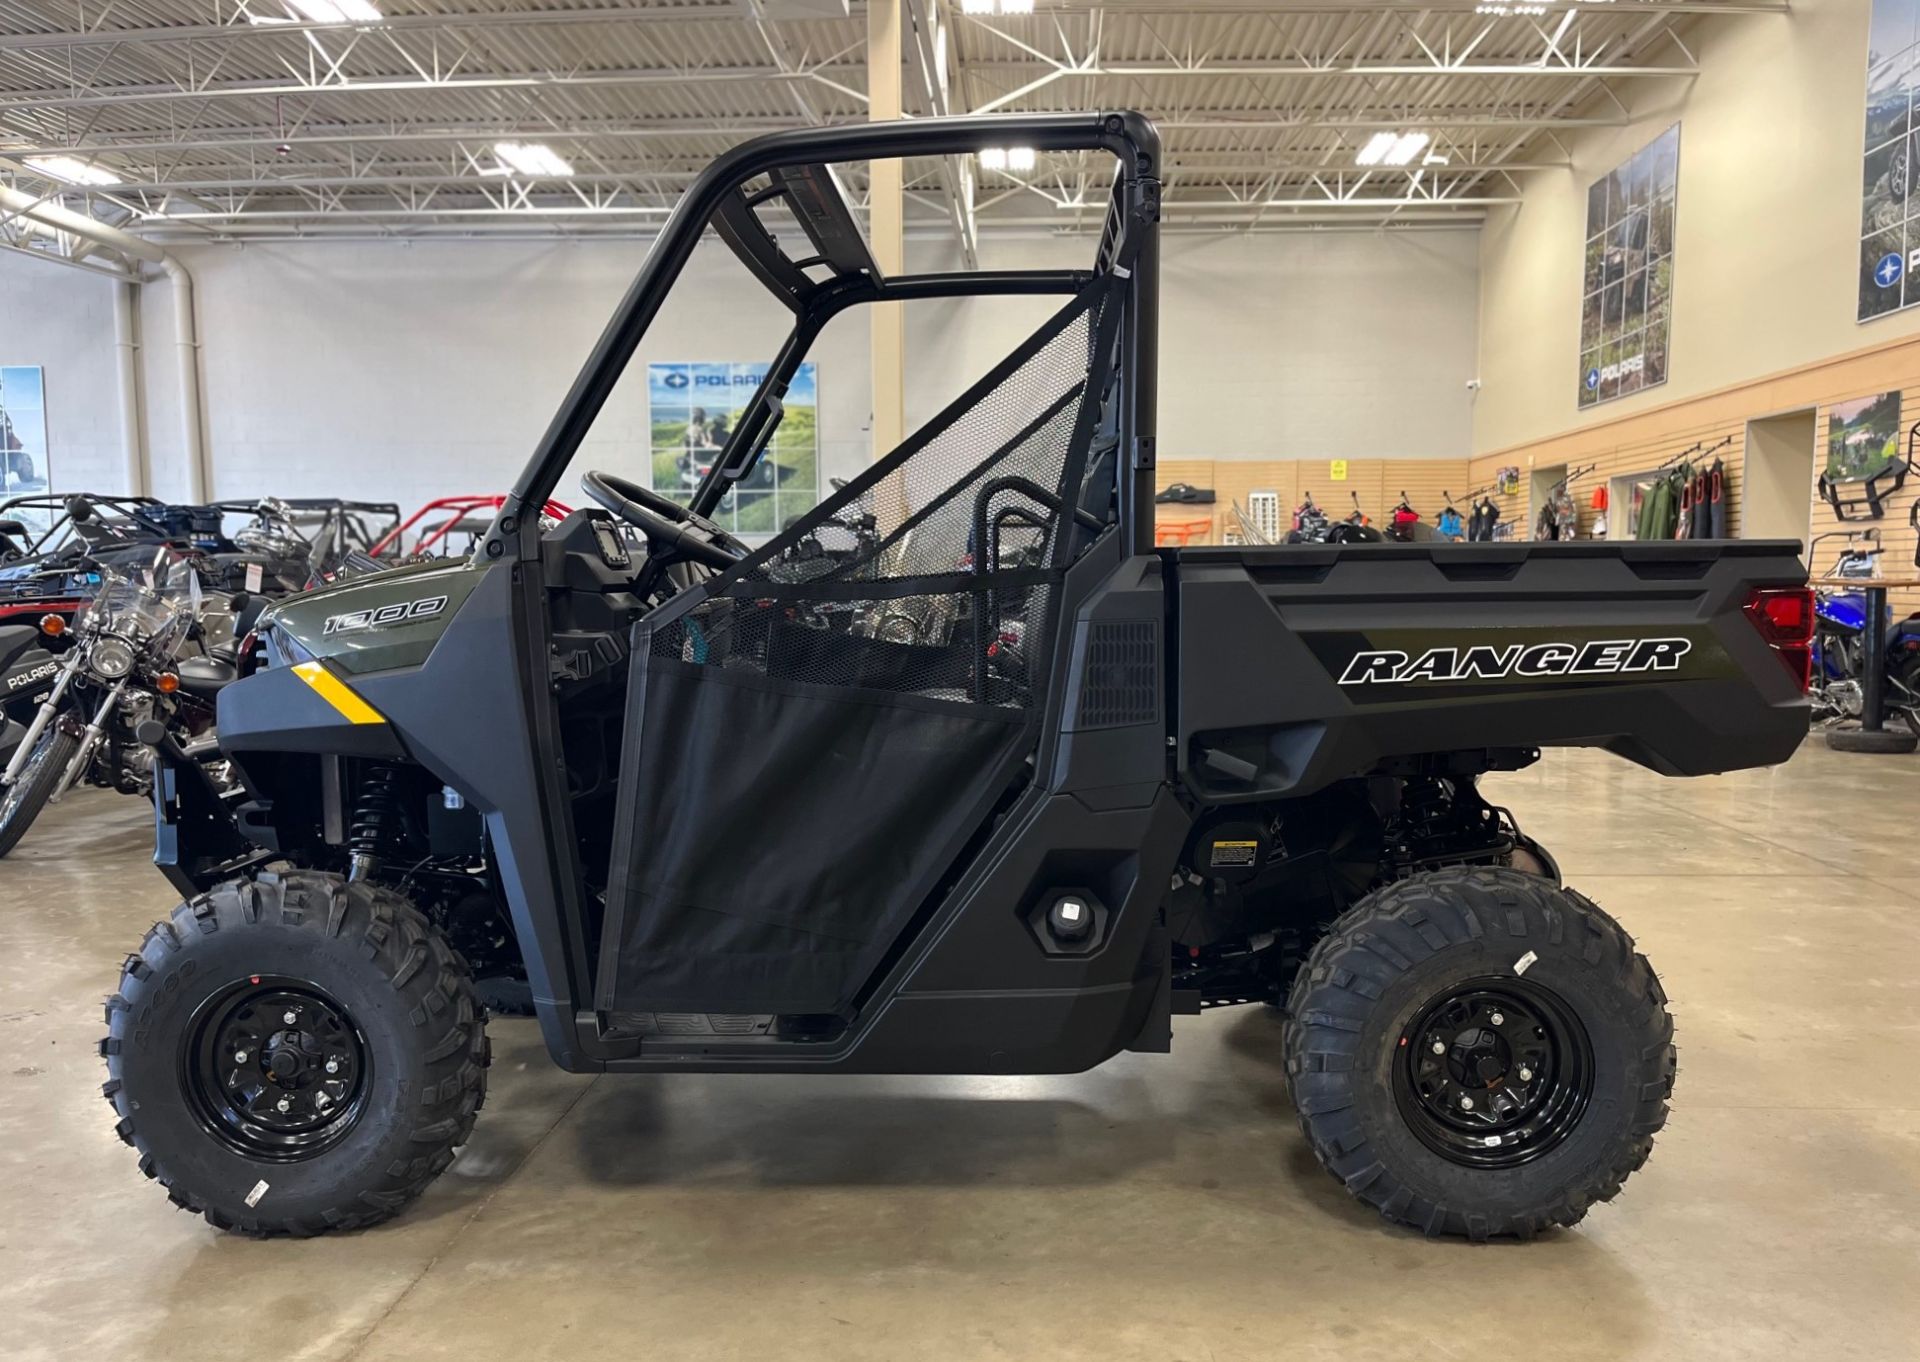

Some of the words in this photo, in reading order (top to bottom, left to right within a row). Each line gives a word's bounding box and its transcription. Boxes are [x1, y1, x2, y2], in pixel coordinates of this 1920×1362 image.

[695, 374, 767, 386] POLARI
[322, 595, 448, 635] 1000
[7, 661, 58, 690] POLARIS
[1337, 637, 1692, 685] RANGER
